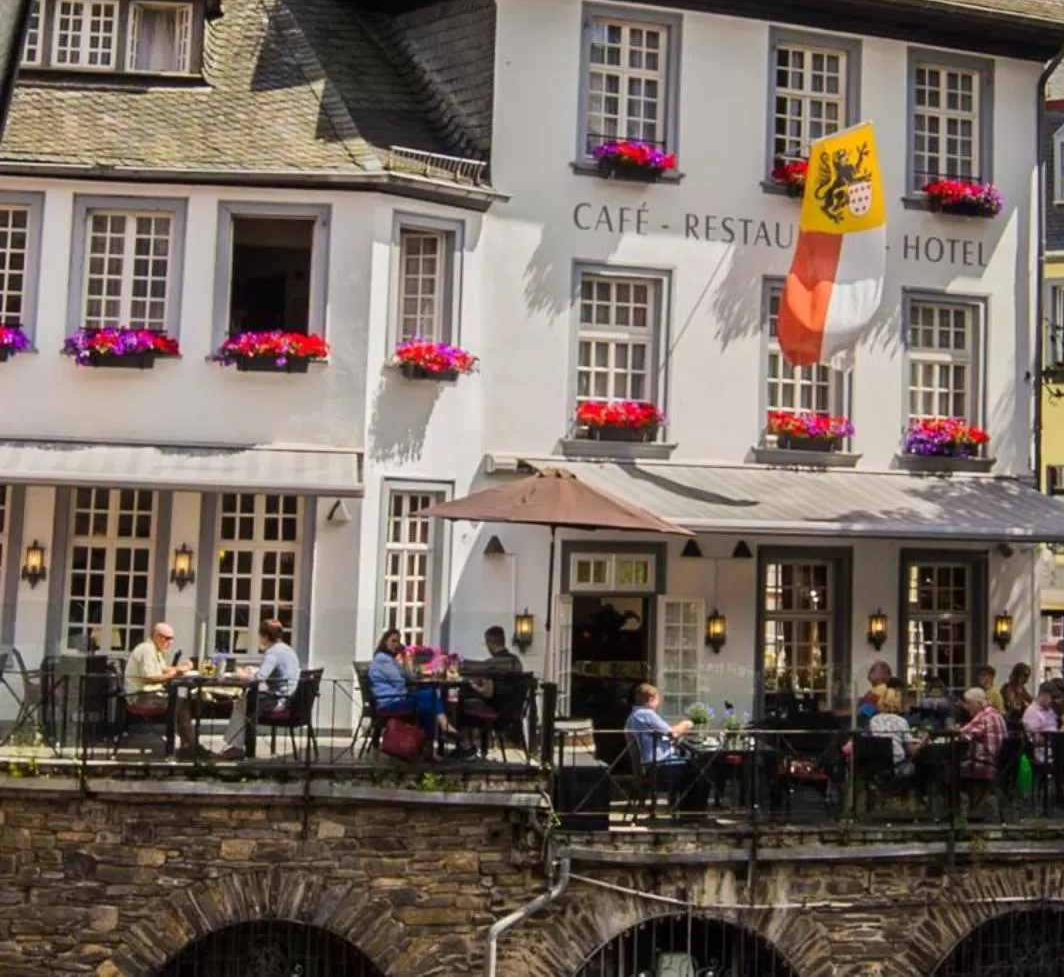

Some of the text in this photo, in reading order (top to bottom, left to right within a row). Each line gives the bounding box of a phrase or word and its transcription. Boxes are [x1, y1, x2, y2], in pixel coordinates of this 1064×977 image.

[573, 201, 649, 235] CAFÉ
[684, 212, 795, 250] RESTAU
[902, 234, 988, 267] HOTEL
